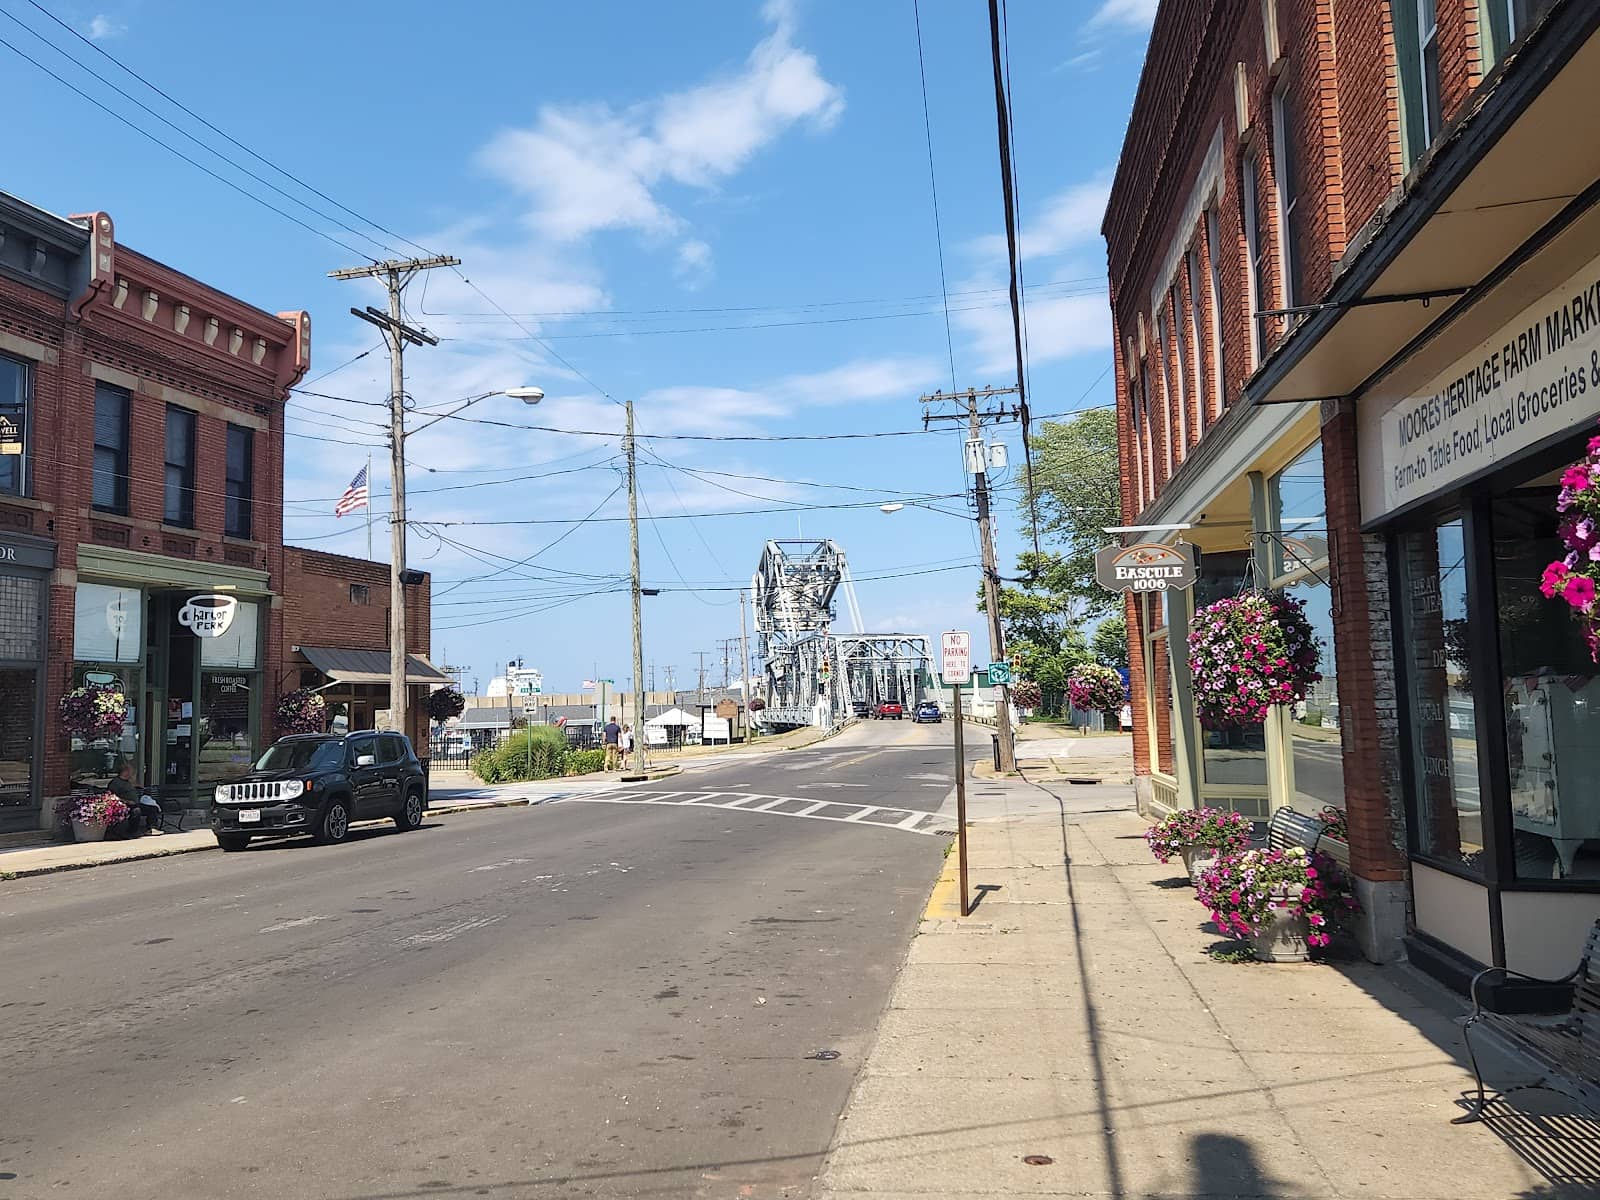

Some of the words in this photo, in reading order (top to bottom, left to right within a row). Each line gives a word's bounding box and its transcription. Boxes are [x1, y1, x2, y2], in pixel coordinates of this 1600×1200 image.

[1399, 395, 1441, 448] MOORES
[1443, 352, 1501, 420] HERITAGE
[1503, 323, 1542, 382] FARM
[1394, 455, 1427, 492] Farm-to
[1428, 438, 1451, 473] Table
[1453, 419, 1482, 460] Food,
[1484, 398, 1514, 443] Local
[1517, 366, 1586, 424] Groceries
[1115, 566, 1183, 580] BASCULE
[1133, 579, 1167, 590] 1006
[197, 621, 224, 630] PERK
[950, 635, 961, 645] NO
[944, 648, 968, 657] PARKING
